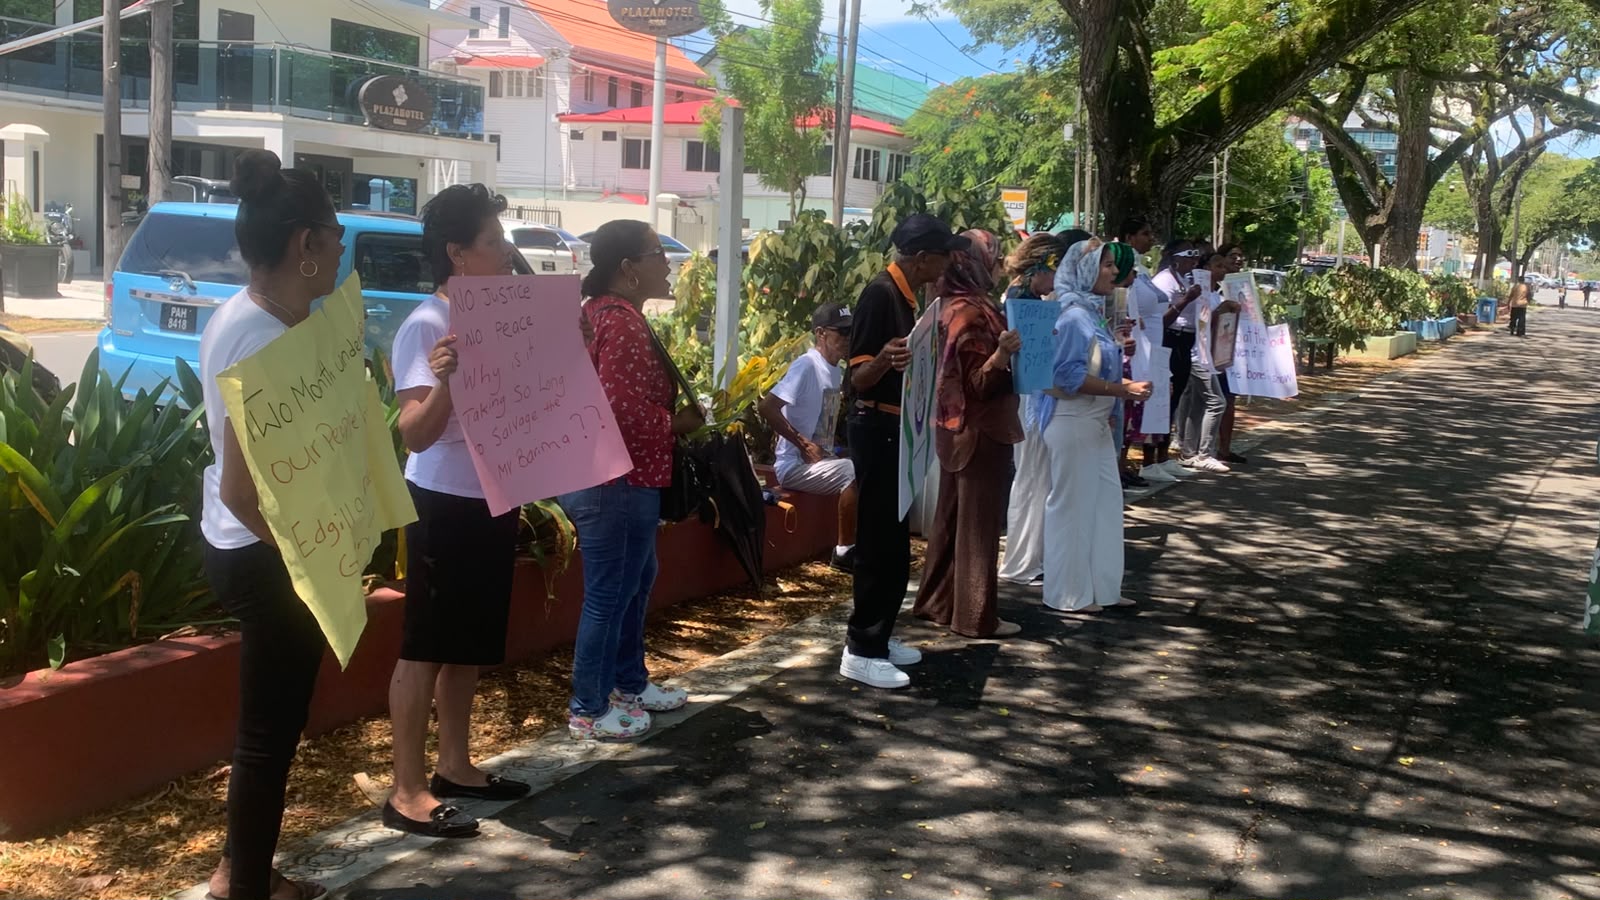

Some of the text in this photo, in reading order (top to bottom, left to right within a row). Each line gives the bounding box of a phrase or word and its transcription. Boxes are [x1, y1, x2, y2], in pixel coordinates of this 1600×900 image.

[453, 287, 475, 315] NO
[171, 306, 188, 318] PAH
[168, 318, 188, 330] 8418
[465, 328, 483, 347] NO
[290, 360, 336, 413] Month
[463, 364, 501, 396] Why
[543, 398, 561, 412] the
